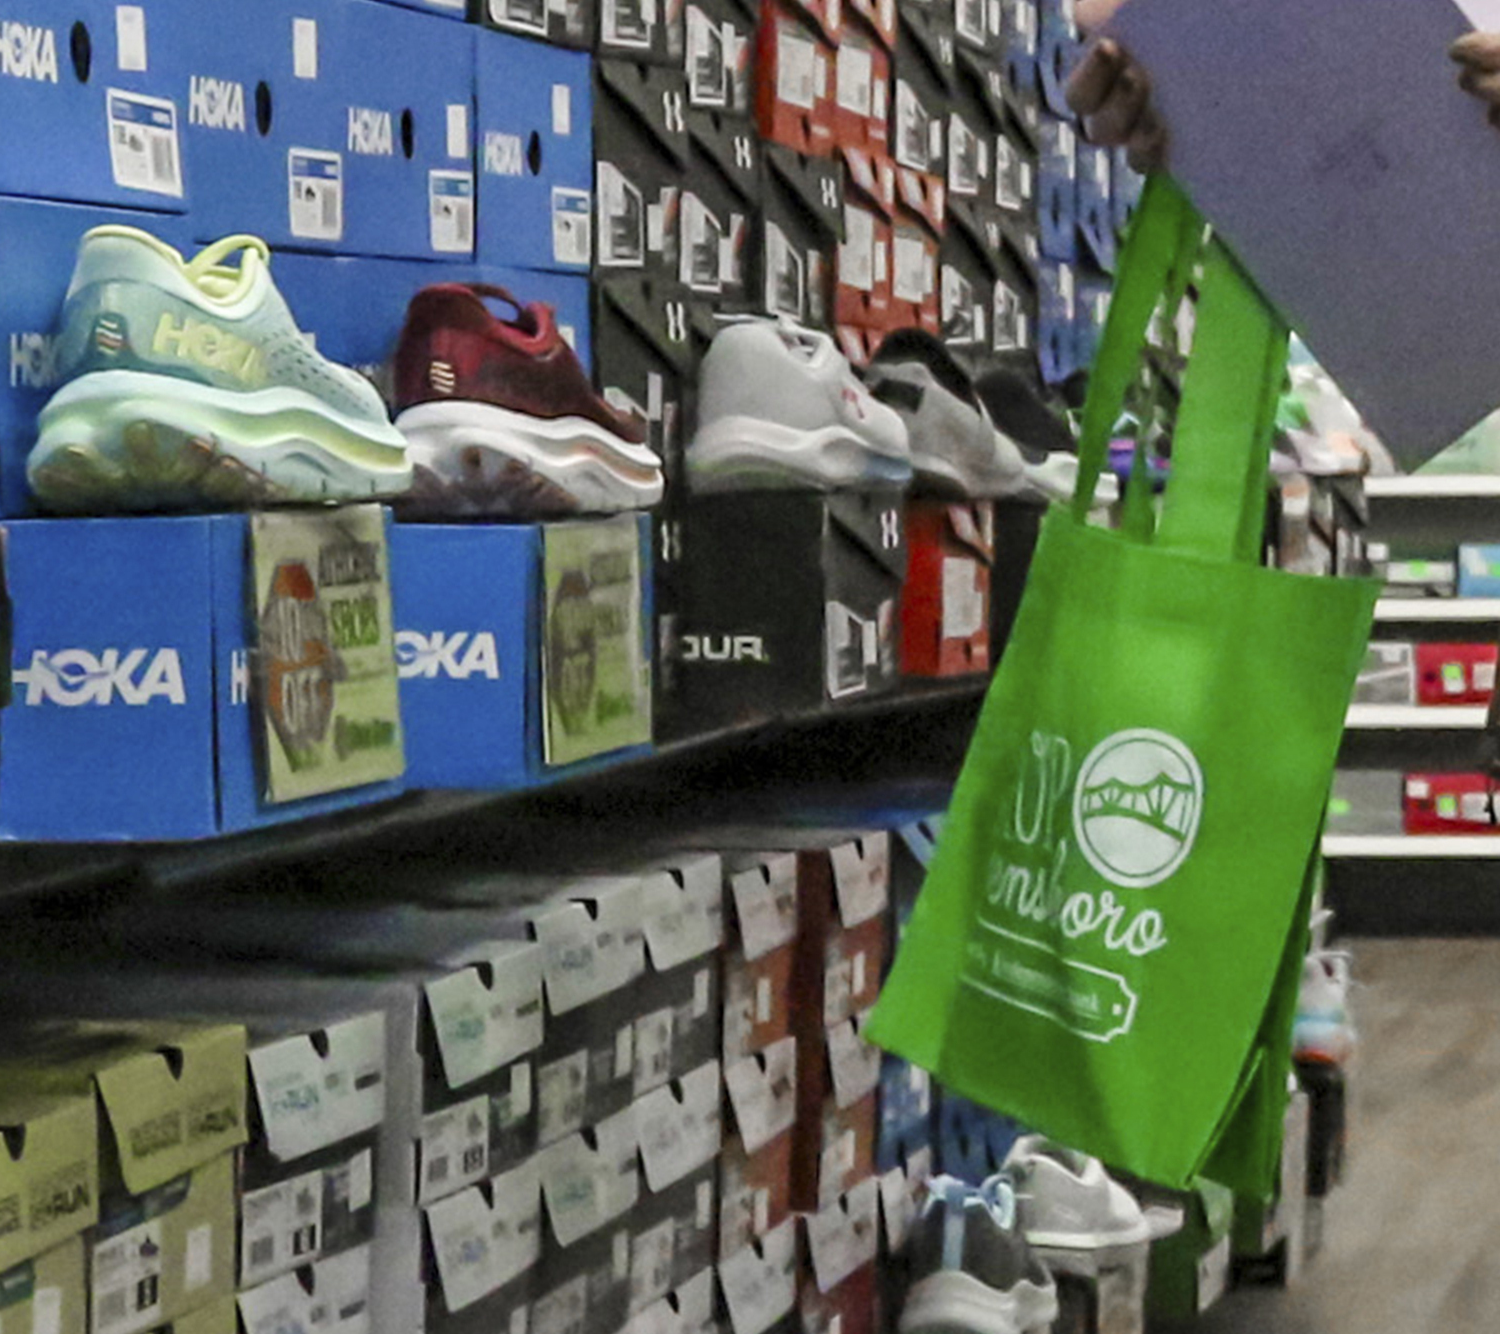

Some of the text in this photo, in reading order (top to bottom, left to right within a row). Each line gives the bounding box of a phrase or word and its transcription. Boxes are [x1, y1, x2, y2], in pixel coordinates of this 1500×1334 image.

[189, 76, 244, 131] HOKA
[348, 107, 392, 155] HOKA
[393, 631, 498, 678] OKA
